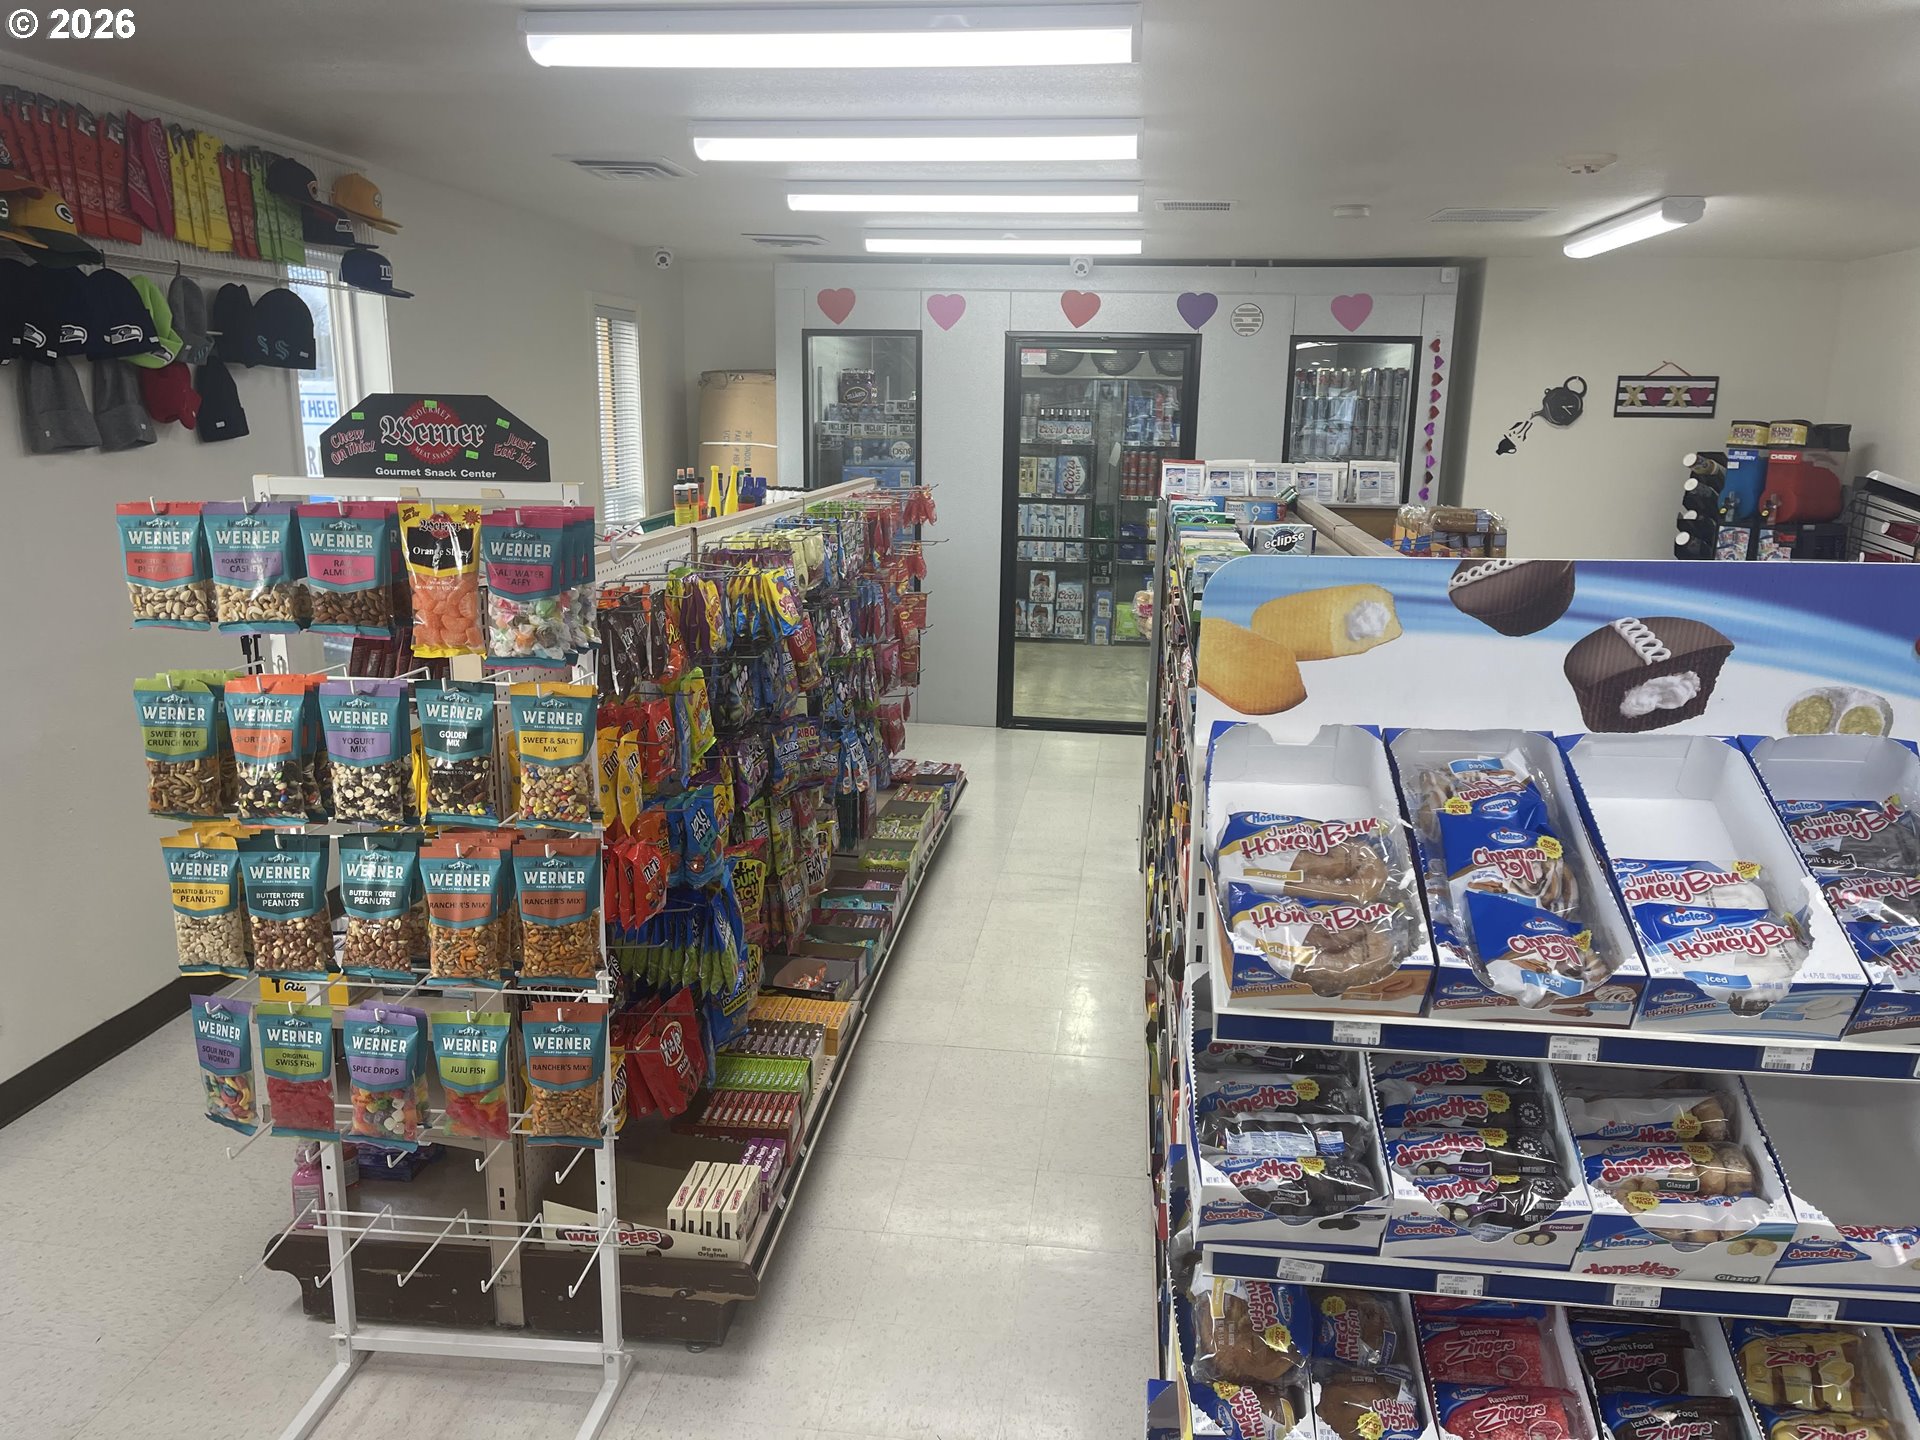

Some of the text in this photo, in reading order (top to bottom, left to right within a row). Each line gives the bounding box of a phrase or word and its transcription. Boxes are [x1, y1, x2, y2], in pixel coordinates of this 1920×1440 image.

[330, 429, 365, 449] Chew
[380, 415, 485, 448] Werner
[347, 439, 376, 457] This!
[493, 443, 516, 457] Eat
[505, 432, 536, 453] Just
[375, 467, 497, 478] Gourmet Snack Center
[128, 530, 191, 545] WERNER
[215, 530, 280, 545] WERNER
[309, 532, 373, 549] WERNER
[1264, 532, 1305, 549] eclipse
[490, 541, 551, 558] WERNER
[142, 706, 206, 721] WERNER
[233, 708, 293, 723] WERNER
[328, 710, 389, 726] WERNER
[425, 703, 483, 721] WERNER
[522, 710, 583, 726] WERNER
[150, 730, 197, 738] SWEET HOT
[342, 737, 375, 745] YOGURT
[439, 731, 468, 740] GOLDEN
[522, 736, 548, 745] SWEET
[556, 737, 578, 745] SALTY
[147, 738, 199, 747] CRUNCH MIX
[350, 745, 367, 753] MIX
[446, 738, 460, 747] MIX
[543, 745, 558, 753] MIX
[1251, 812, 1292, 823] Hostess
[1801, 812, 1851, 828] Jumbo
[1266, 823, 1314, 838] Jumbo
[1495, 832, 1526, 843] Hostess
[1472, 847, 1547, 867] Cinnamon
[1807, 856, 1851, 866] vil's Food
[170, 862, 229, 878] WERNER
[250, 865, 311, 880] WERNER
[346, 863, 404, 879] WERNER
[523, 870, 585, 885] WERNER
[808, 865, 825, 885] MIX
[1256, 871, 1288, 880] Glazed
[429, 872, 491, 887] WERNER
[1625, 871, 1674, 888] Jumbo
[180, 895, 217, 904] PEANUTS
[256, 892, 305, 900] BUTTER TOFFEE
[348, 889, 397, 898] BUTTER TOFFEE
[354, 896, 391, 906] PEANUTS
[524, 897, 565, 905] RANCHER'S
[262, 899, 299, 907] PEANUTS
[1668, 910, 1712, 924] Hostess
[1694, 926, 1744, 943] Jumbo
[1540, 976, 1562, 988] Iced
[1705, 974, 1728, 984] Iced
[198, 1020, 241, 1041] WERNER
[267, 1028, 322, 1045] WERNER
[352, 1035, 407, 1054] WERNER
[442, 1037, 497, 1054] WERNER
[532, 1036, 591, 1051] WERNER
[275, 1058, 315, 1068] SWISS FISH
[281, 1052, 310, 1060] ORIGINAL
[352, 1065, 399, 1076] SPICE DROPS
[450, 1065, 486, 1075] JUJU FISH
[532, 1064, 572, 1072] RANCHER'S
[1403, 1097, 1488, 1128] donettes
[1602, 1124, 1633, 1135] Hostess
[1396, 1132, 1485, 1166] donettes
[1458, 1165, 1484, 1174] Frosted
[1601, 1147, 1693, 1183] donettes
[1229, 1159, 1302, 1188] onettes
[1666, 1180, 1691, 1190] Glazed
[1204, 1209, 1264, 1221] donettes
[565, 1230, 661, 1246] WHPERS
[1395, 1226, 1457, 1236] donettes
[1600, 1237, 1650, 1248] Hostess
[1789, 1248, 1857, 1260] donettes
[1582, 1261, 1681, 1278] donettes
[1716, 1274, 1760, 1284] Glazed
[1255, 1281, 1279, 1328] MEGA
[1334, 1312, 1348, 1359] MEGA
[1347, 1309, 1359, 1361] muffin
[1459, 1328, 1500, 1338] Raspberry
[1444, 1337, 1516, 1365] Zingers
[1605, 1342, 1633, 1353] Devil's
[1633, 1342, 1654, 1351] Food
[1594, 1351, 1667, 1379] Zingers
[1454, 1388, 1488, 1400] Hostess
[1487, 1393, 1530, 1405] Raspberry
[1230, 1390, 1252, 1438] MEGA
[1240, 1385, 1266, 1437] muffin
[1372, 1398, 1415, 1416] muffin
[1379, 1414, 1420, 1431] MEGA
[1473, 1402, 1548, 1434] Zingers
[1630, 1410, 1699, 1429] Iced Food
